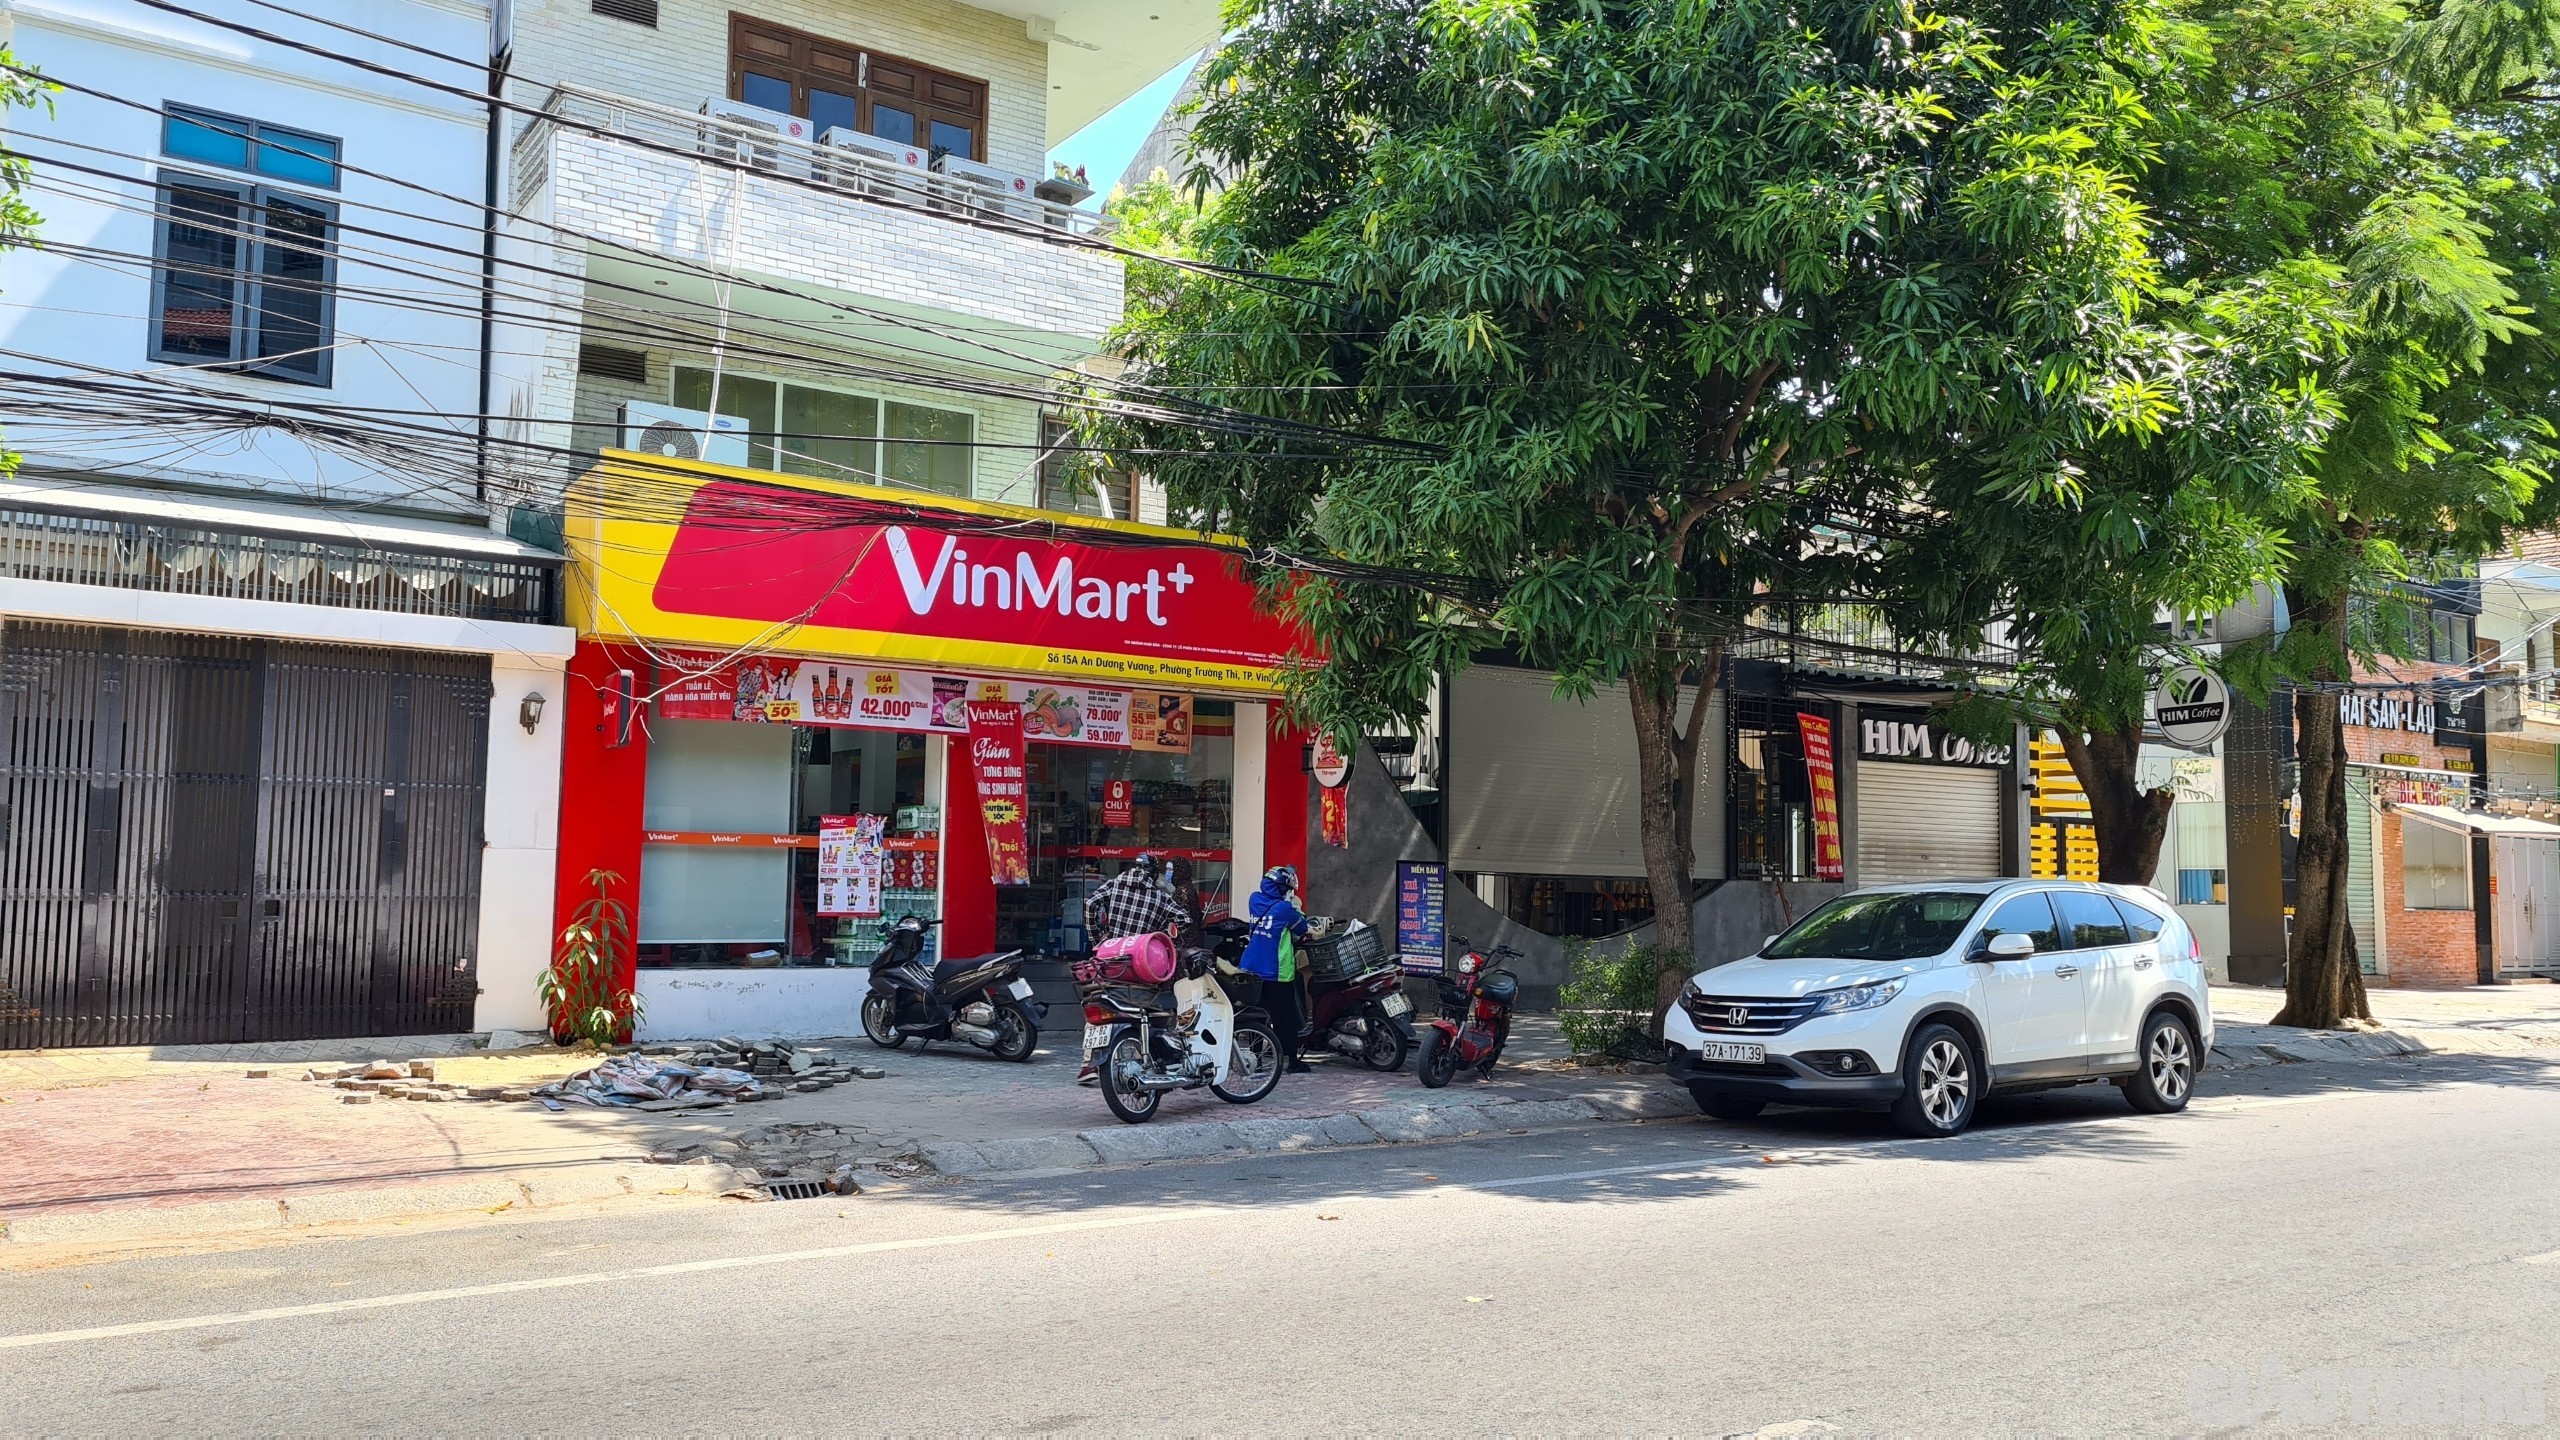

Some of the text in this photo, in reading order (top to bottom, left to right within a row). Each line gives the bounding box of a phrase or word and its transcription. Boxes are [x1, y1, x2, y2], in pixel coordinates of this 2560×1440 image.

[885, 525, 1194, 626] VinMart+
[1048, 652, 1059, 663] Số
[1062, 654, 1078, 665] 15A
[1081, 656, 1092, 666] An
[1096, 657, 1124, 671] Dương
[1160, 664, 1191, 677] Phường
[1194, 667, 1222, 680] Trường
[1243, 671, 1253, 680] TP.
[2162, 707, 2220, 722] HIM Coffee
[1863, 719, 1933, 758] HIM
[1105, 799, 1122, 810] CHÚ
[1400, 920, 1420, 930] GAME
[1705, 1043, 1761, 1061] 37A-171.39
